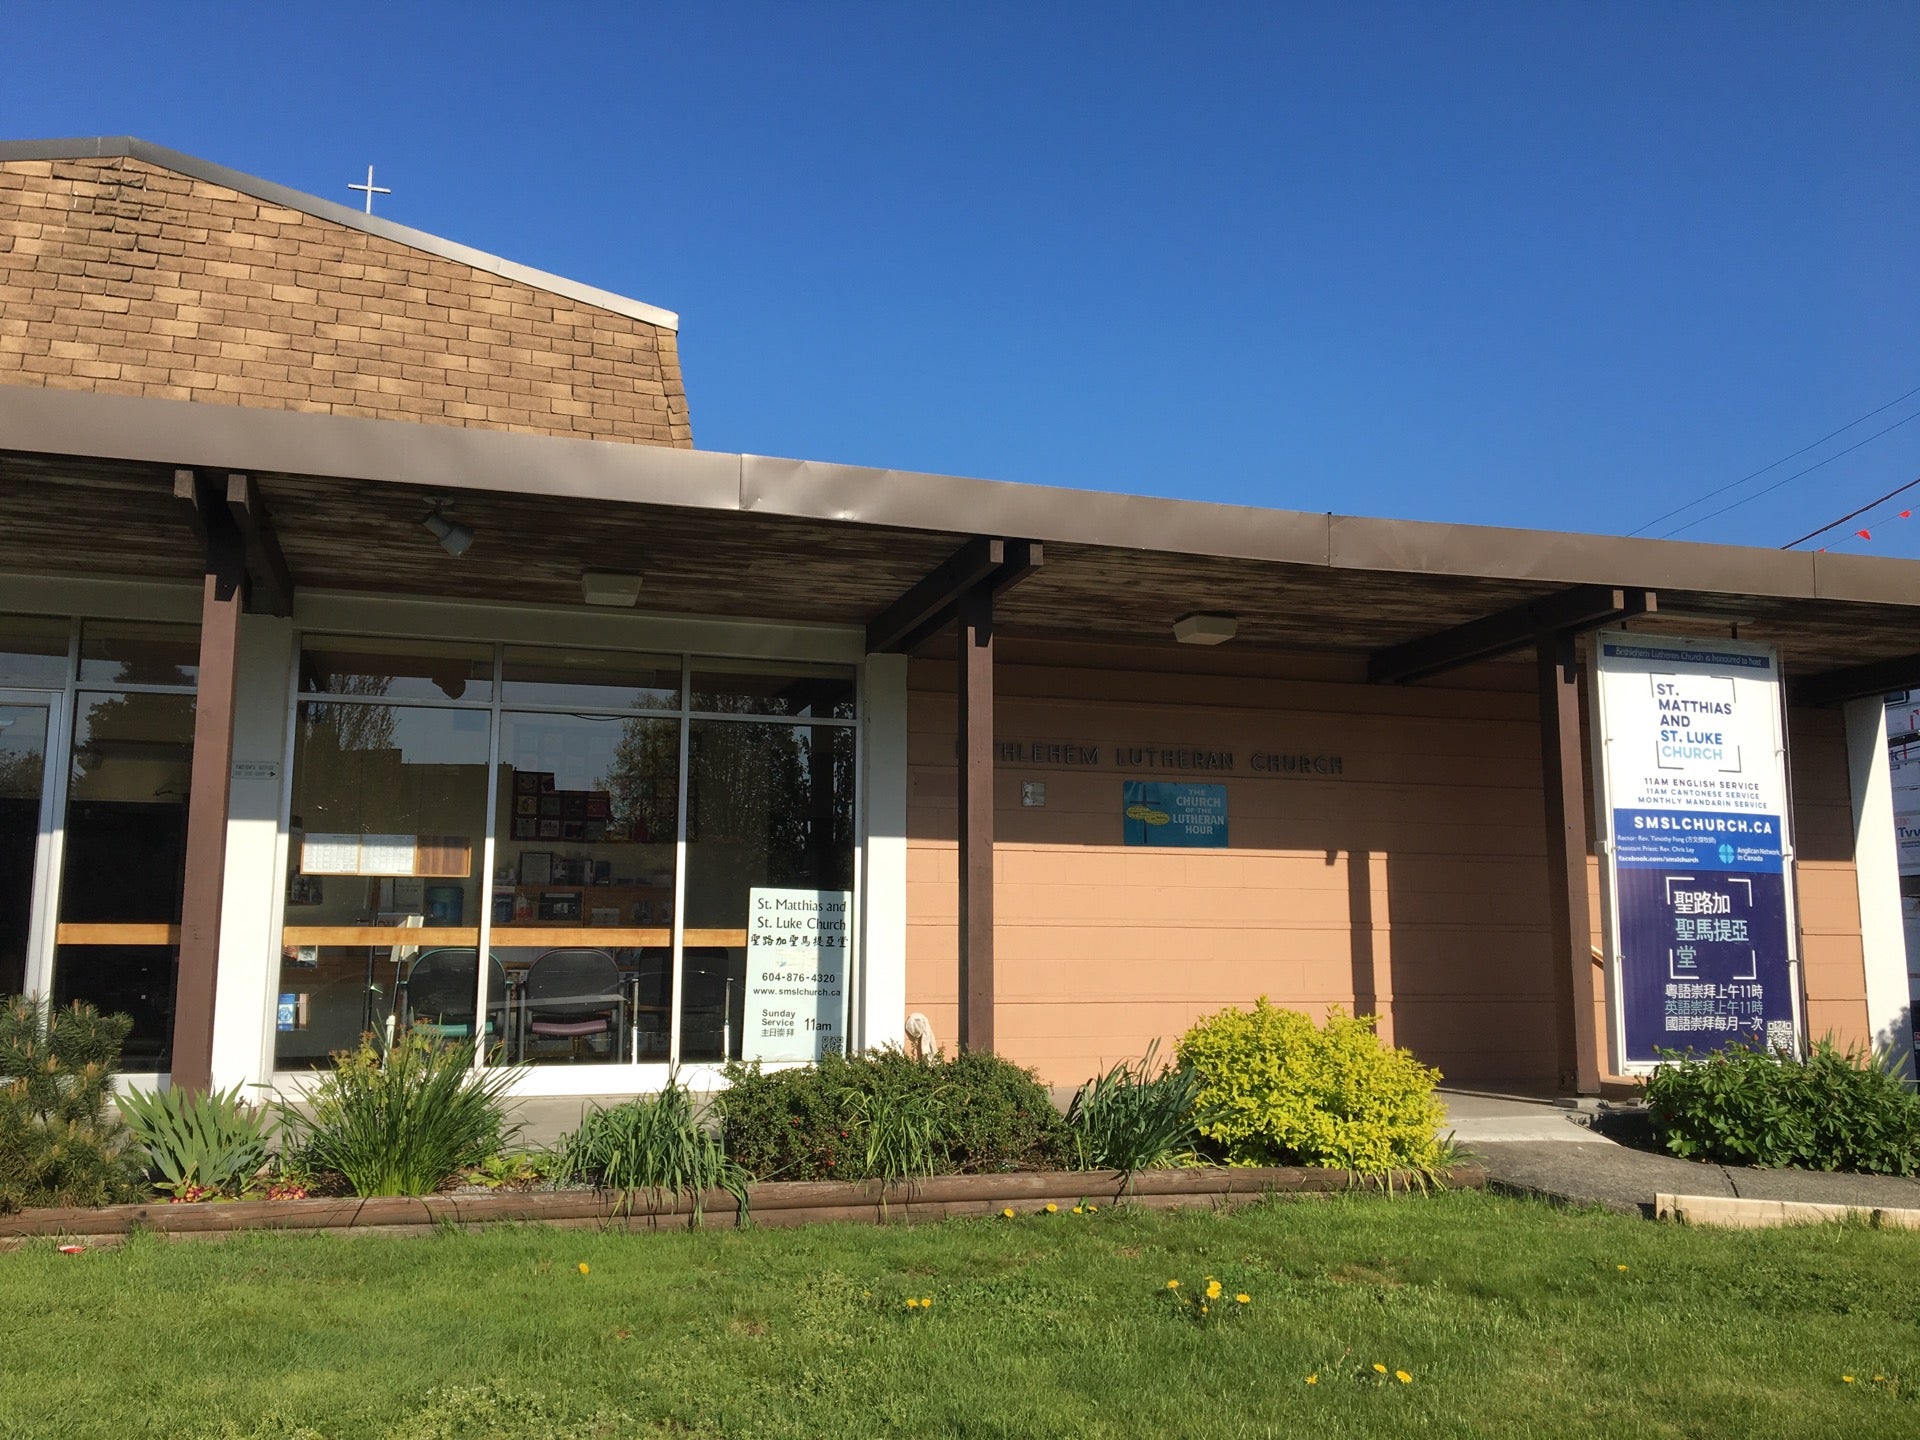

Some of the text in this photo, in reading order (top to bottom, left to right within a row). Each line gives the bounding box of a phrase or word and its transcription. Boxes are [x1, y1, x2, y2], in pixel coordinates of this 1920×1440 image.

[1681, 651, 1705, 662] Church
[1711, 653, 1741, 664] honoured
[1741, 657, 1748, 665] to
[1749, 656, 1762, 667] host
[1656, 683, 1680, 696] ST.
[1658, 699, 1732, 715] MATTHIAS
[1660, 714, 1691, 728] AND
[1661, 730, 1723, 745] ST. LUKE
[1662, 745, 1723, 760] CHURCH
[1116, 747, 1234, 770] LUTHERAN
[1251, 752, 1343, 775] CHURCH
[1644, 777, 1760, 791] 11AM ENGLISH SERVICE
[1175, 796, 1221, 807] CHURCH
[1671, 789, 1722, 798] CANTONESE
[1726, 791, 1760, 800] SERVICE
[1638, 796, 1767, 809] MONTHLY MANDARIN SERVICE
[1172, 814, 1225, 825] LUTHERAN
[1634, 816, 1772, 834] SMSLCHURCH.CA
[1185, 825, 1213, 835] HOUR
[1737, 847, 1780, 856] Anglican Network
[1618, 855, 1699, 863] facebook.com/smslchurch
[757, 898, 846, 913] St. Matthias and
[1674, 890, 1730, 915] 聖路加
[757, 916, 846, 930] St. Luke Church
[1675, 918, 1749, 942] 聖馬提亞
[751, 934, 848, 948] 聖路加聖馬提亞堂
[1677, 945, 1698, 969] 堂
[762, 972, 835, 983] 604-876-4320
[753, 987, 841, 997] www.smslchurch.ca
[1665, 983, 1763, 999] 粵語崇拜上午11時
[762, 1009, 796, 1018] Sunday
[1665, 1000, 1763, 1015] 英語崇拜上午11時
[762, 1018, 832, 1031] Service 11am
[1665, 1016, 1763, 1031] 國語崇拜每月一次
[761, 1028, 795, 1038] 主日崇拜
